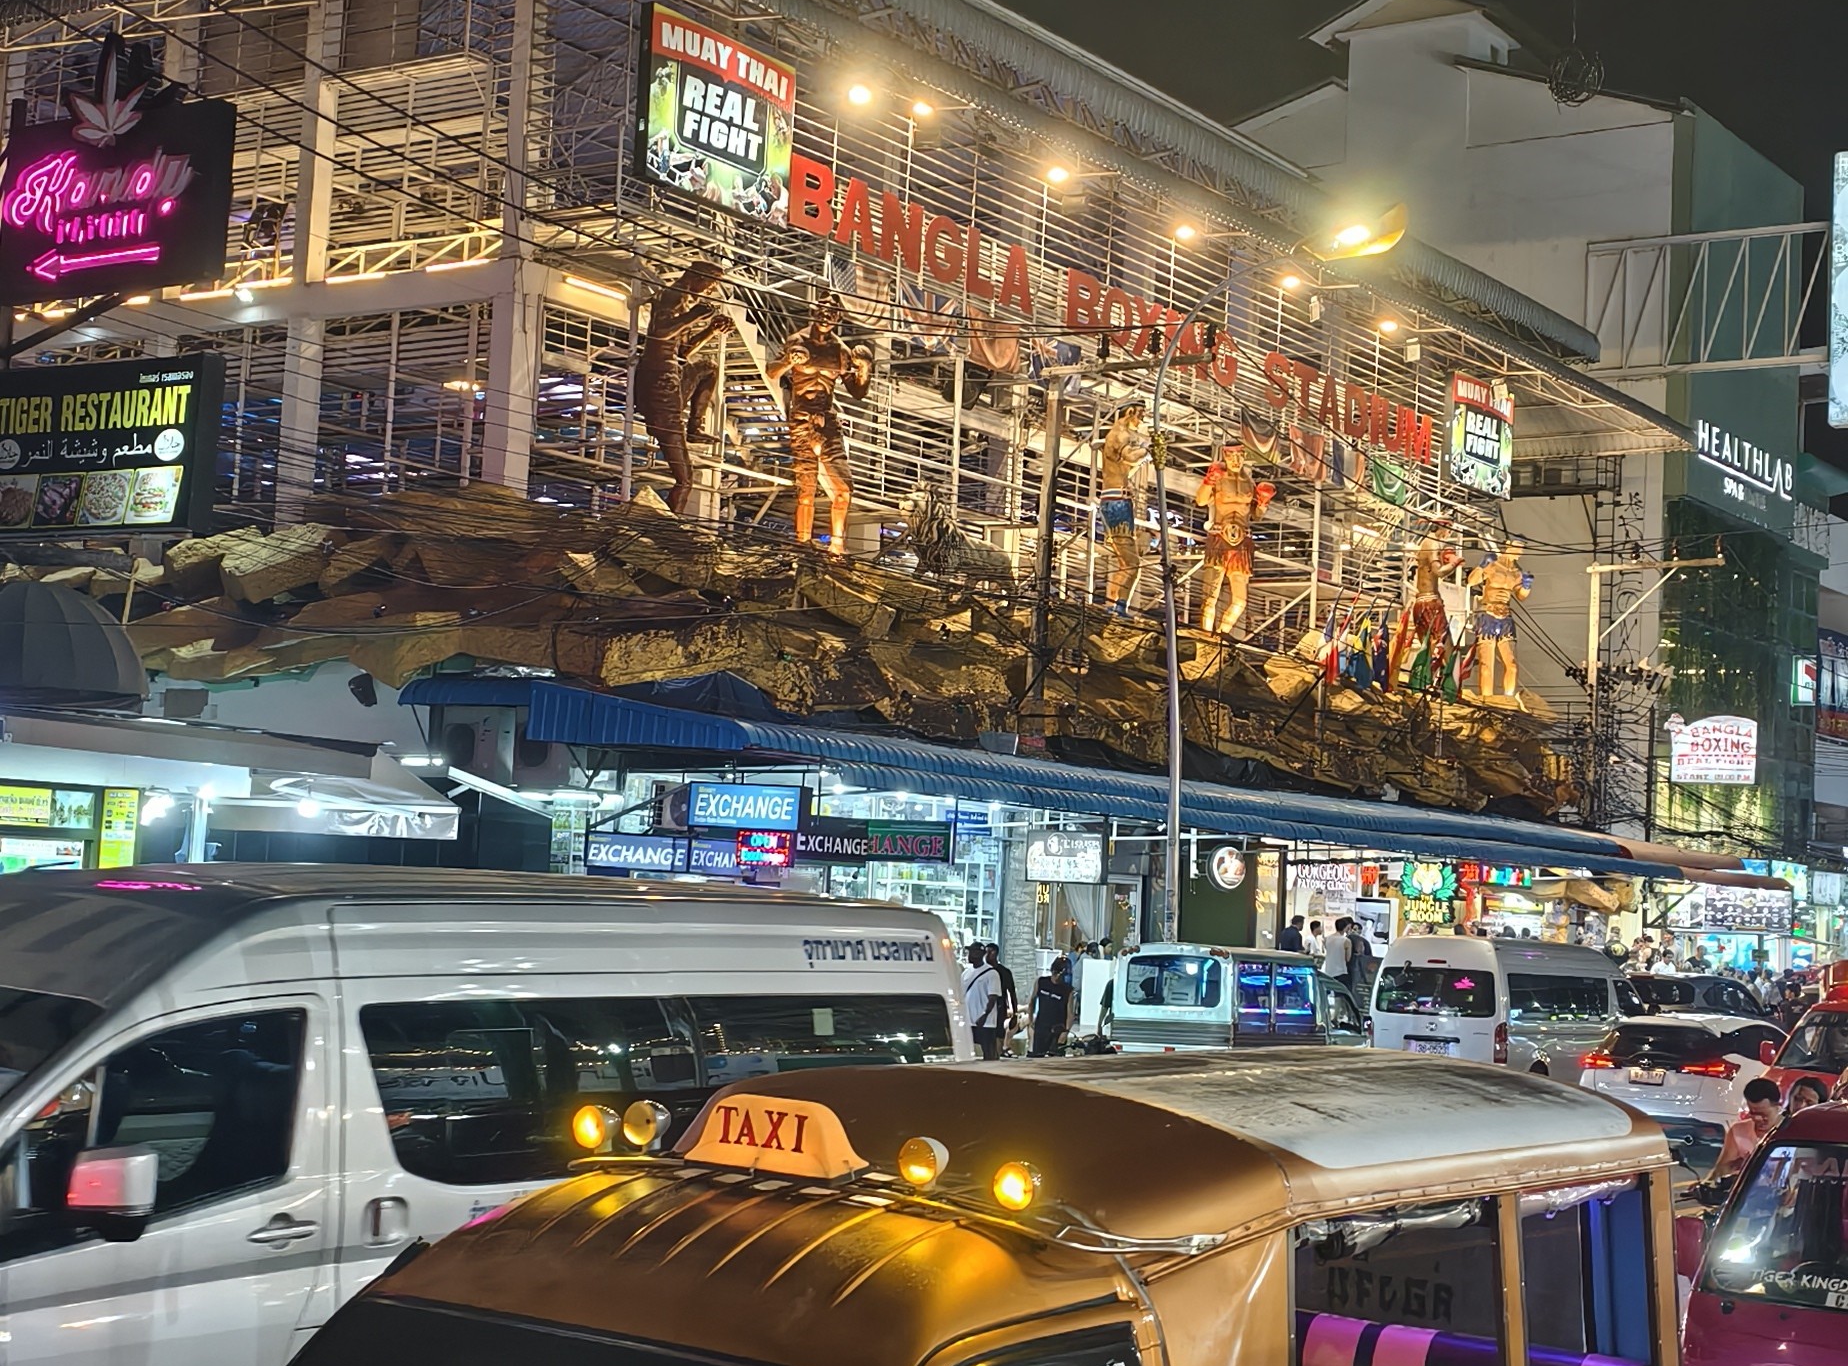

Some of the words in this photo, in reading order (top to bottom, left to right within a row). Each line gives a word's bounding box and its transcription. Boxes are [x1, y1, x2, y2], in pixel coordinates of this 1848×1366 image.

[661, 22, 733, 70] MUAY
[736, 51, 789, 102] THAI
[682, 75, 760, 132] REAL
[682, 110, 763, 161] FIGHT
[788, 152, 1034, 316] BANGLA
[1066, 267, 1238, 386] BOXING
[1263, 351, 1433, 465] STADIUM
[1457, 379, 1488, 404] MUAY
[0, 396, 52, 435] TIGER
[61, 385, 192, 432] RESTAURANT
[1466, 411, 1499, 440] REAL
[112, 433, 153, 468] مطعم
[1465, 433, 1500, 460] FIGHT
[1698, 419, 1793, 493] HEALTHLAB
[1690, 723, 1753, 738] BANGLA
[1690, 737, 1752, 753] BOXING
[694, 793, 795, 821] EXCHANGE
[587, 842, 686, 866] EXCHANGE
[795, 832, 868, 856] EXCHANGE
[691, 850, 750, 869] EXCHAN
[1404, 899, 1450, 913] JUNGLE
[1409, 910, 1444, 924] ROOM
[716, 1105, 808, 1153] TAXI
